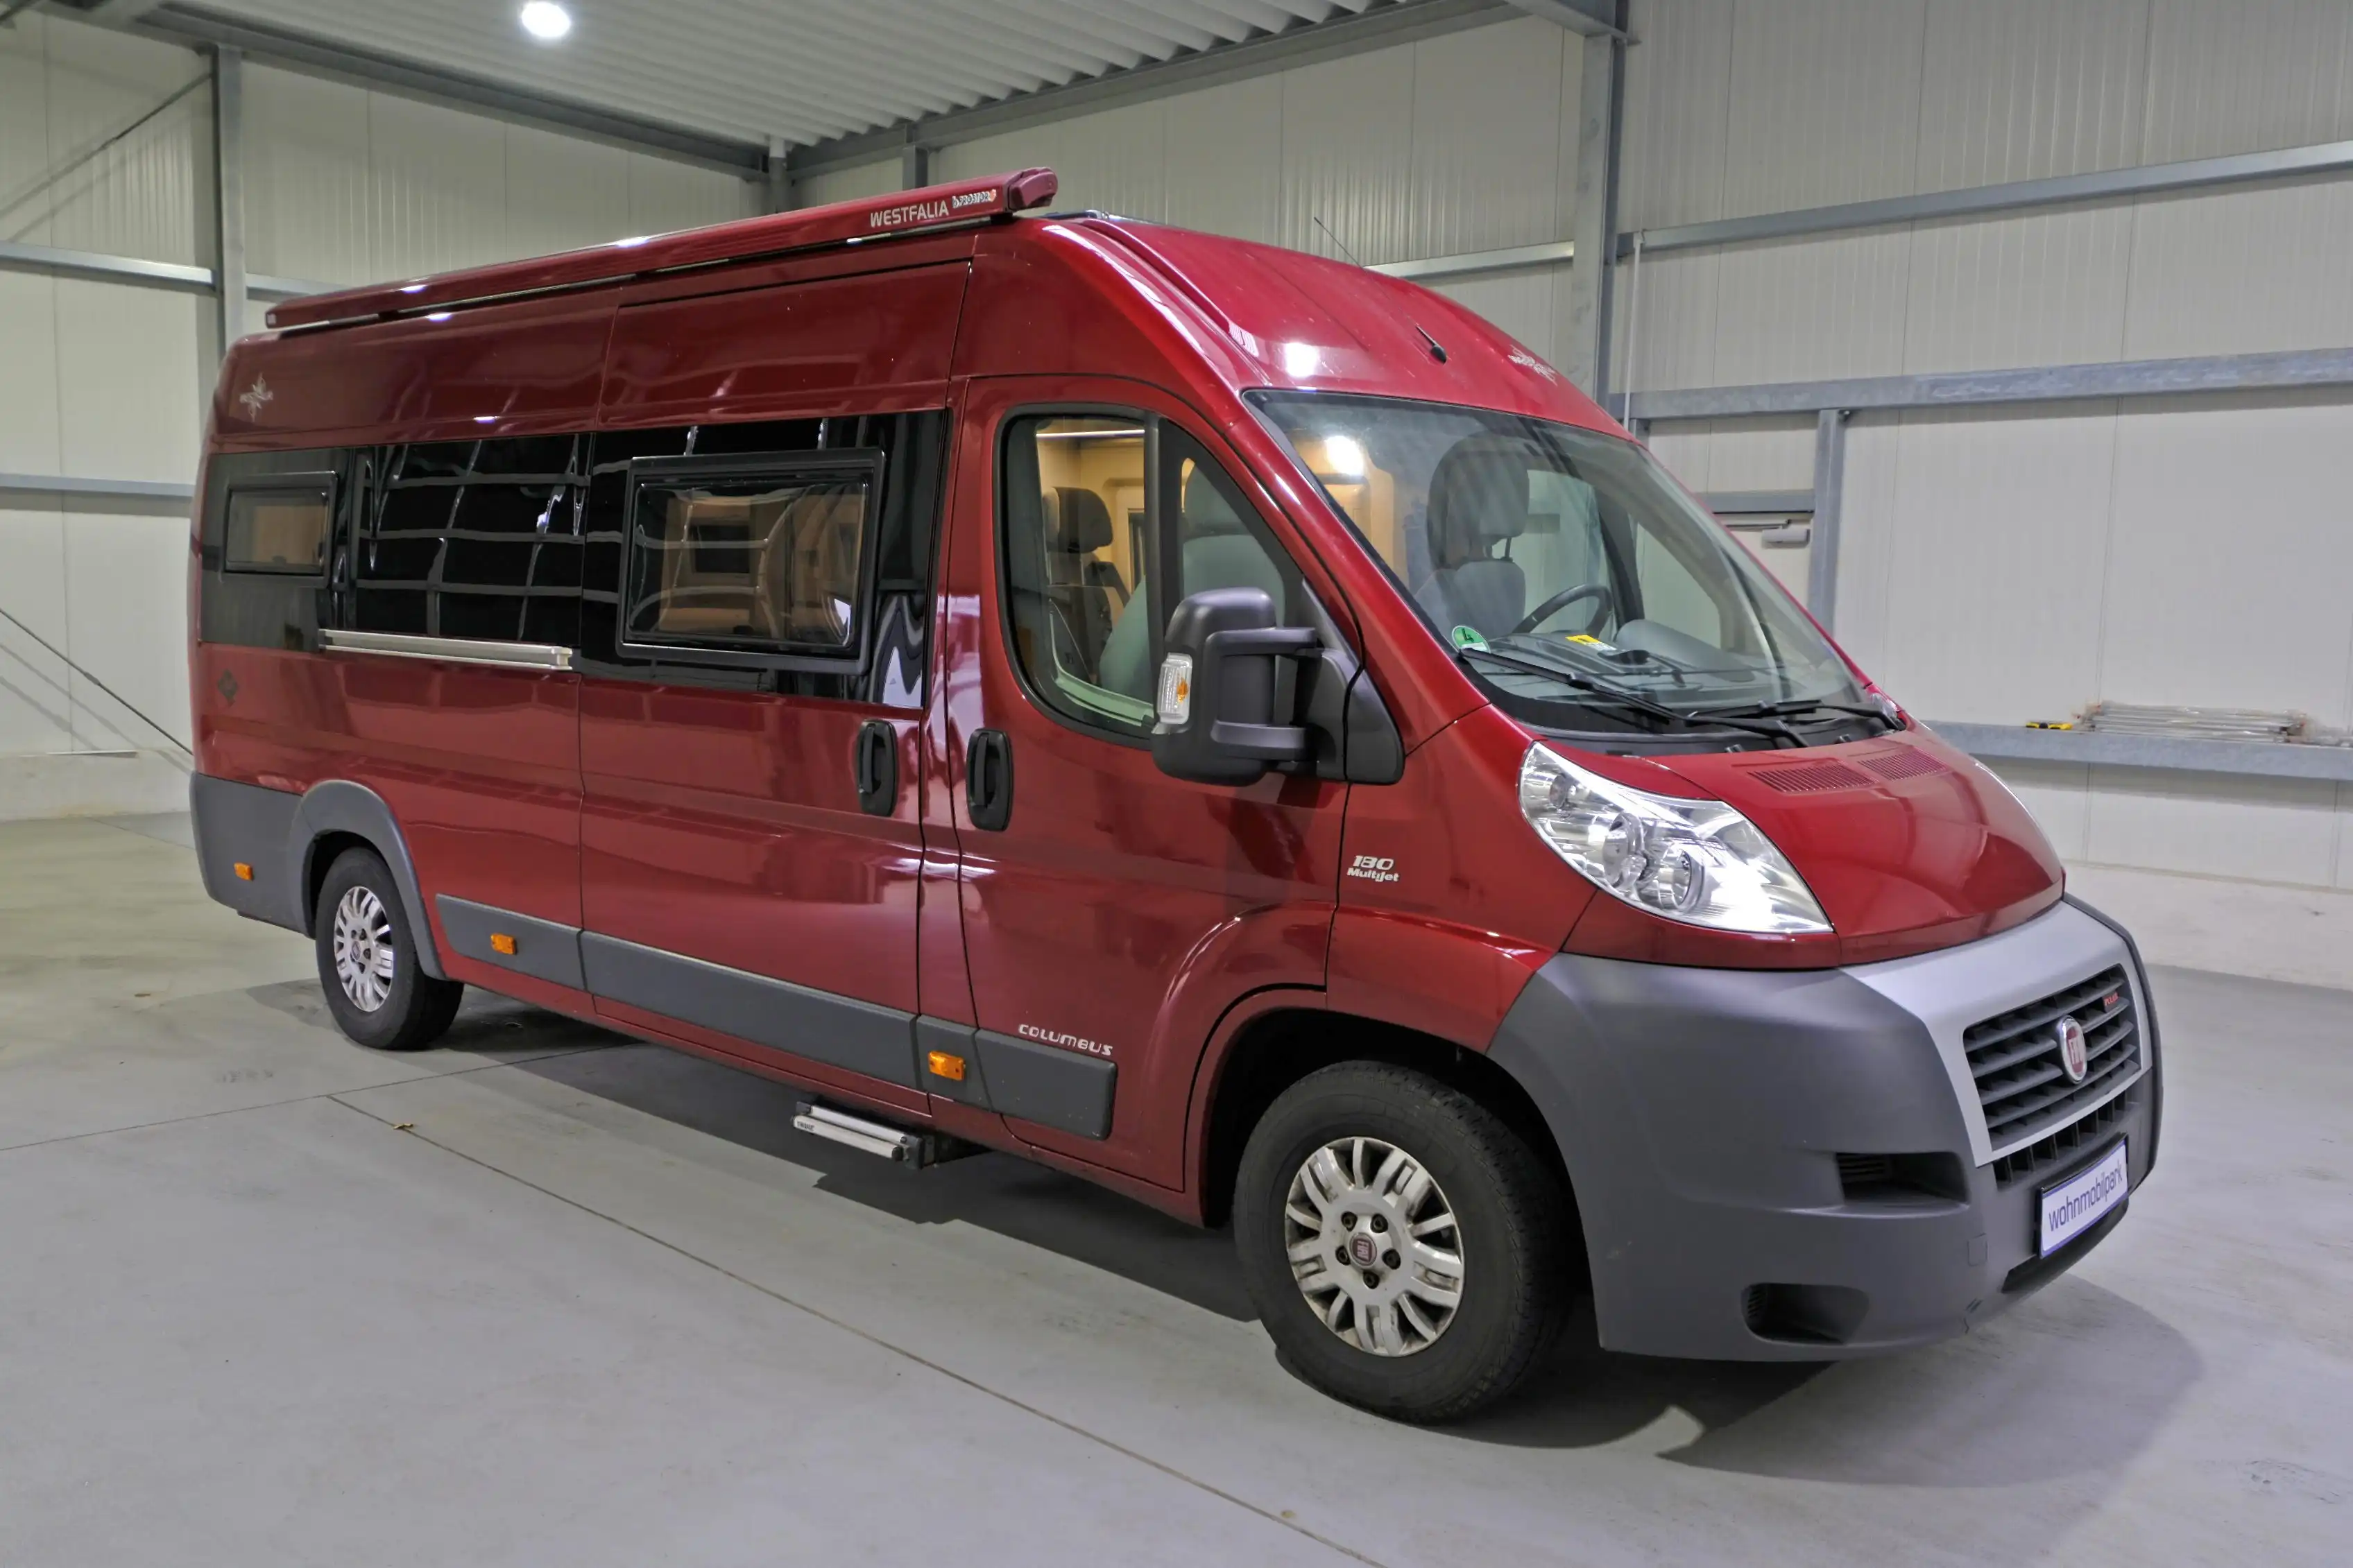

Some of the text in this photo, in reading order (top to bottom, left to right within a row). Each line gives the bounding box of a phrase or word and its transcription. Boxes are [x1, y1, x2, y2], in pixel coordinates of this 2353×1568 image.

[870, 200, 949, 227] WESTFALIA
[1462, 628, 1474, 643] 4
[2048, 1159, 2123, 1232] wohnmobilpark
